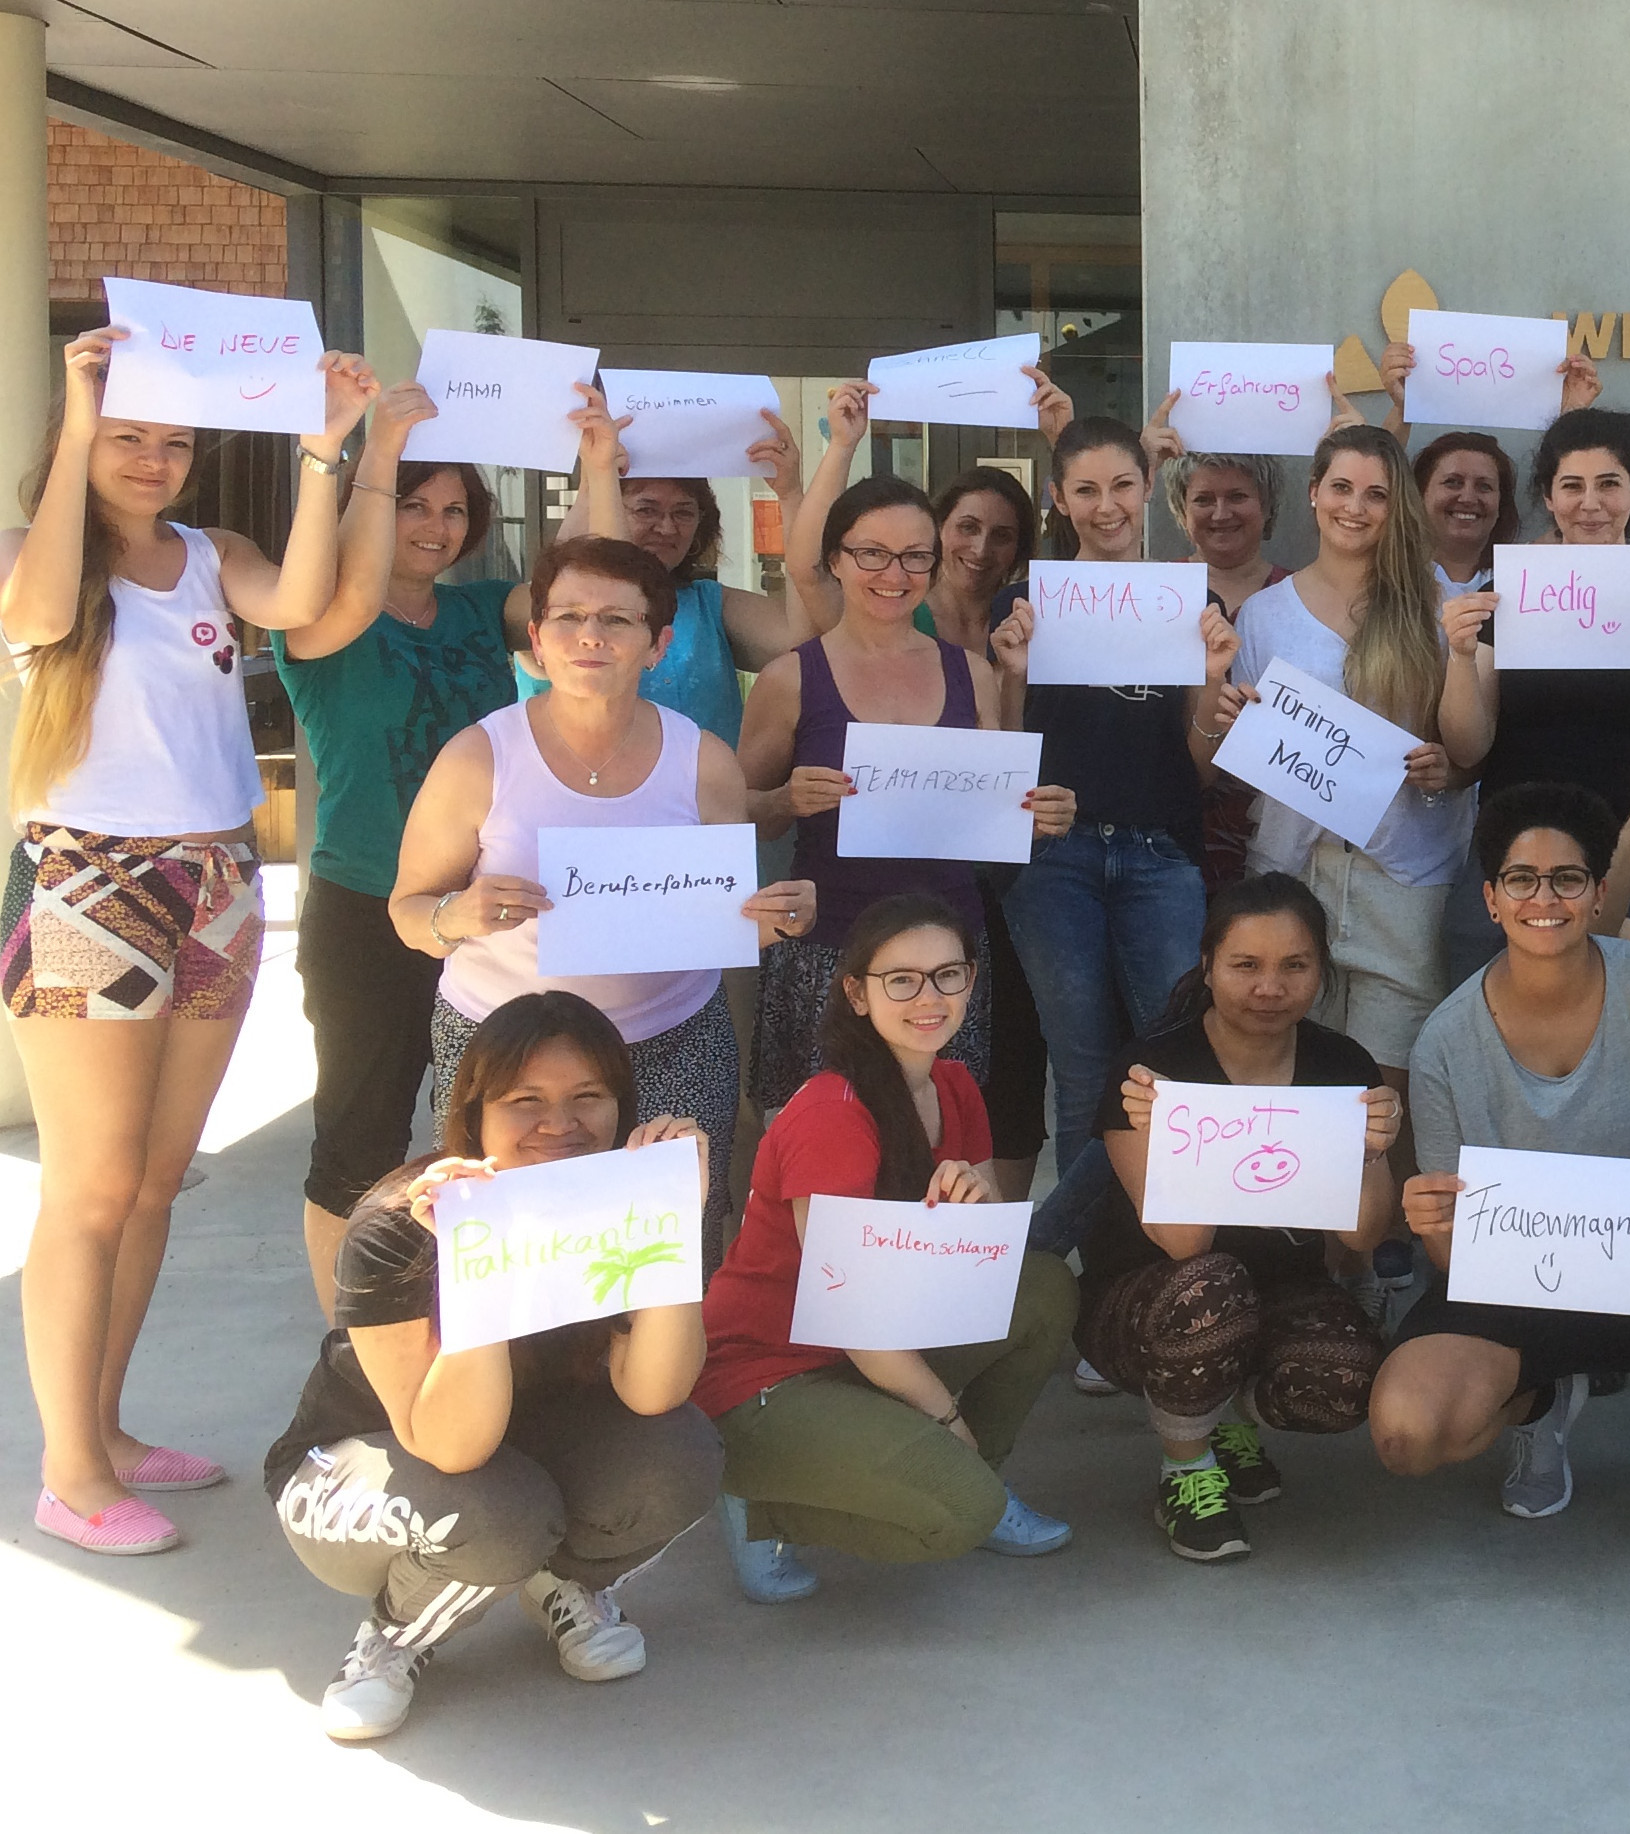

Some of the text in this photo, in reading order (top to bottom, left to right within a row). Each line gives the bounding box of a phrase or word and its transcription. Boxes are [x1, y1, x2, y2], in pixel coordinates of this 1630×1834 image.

[160, 319, 300, 355] DIE NEUE
[1435, 342, 1516, 385] Spaß
[446, 379, 502, 400] MAMA
[625, 394, 717, 411] Schwimmen
[1190, 370, 1300, 412] Erfahrung
[1039, 576, 1143, 622] MAMA
[1519, 568, 1597, 629] Ledig
[1269, 680, 1366, 767] Tuning
[1268, 738, 1337, 803] Maus
[561, 866, 738, 898] Berufserfahrung
[861, 1224, 1010, 1268] Brillenschlange
